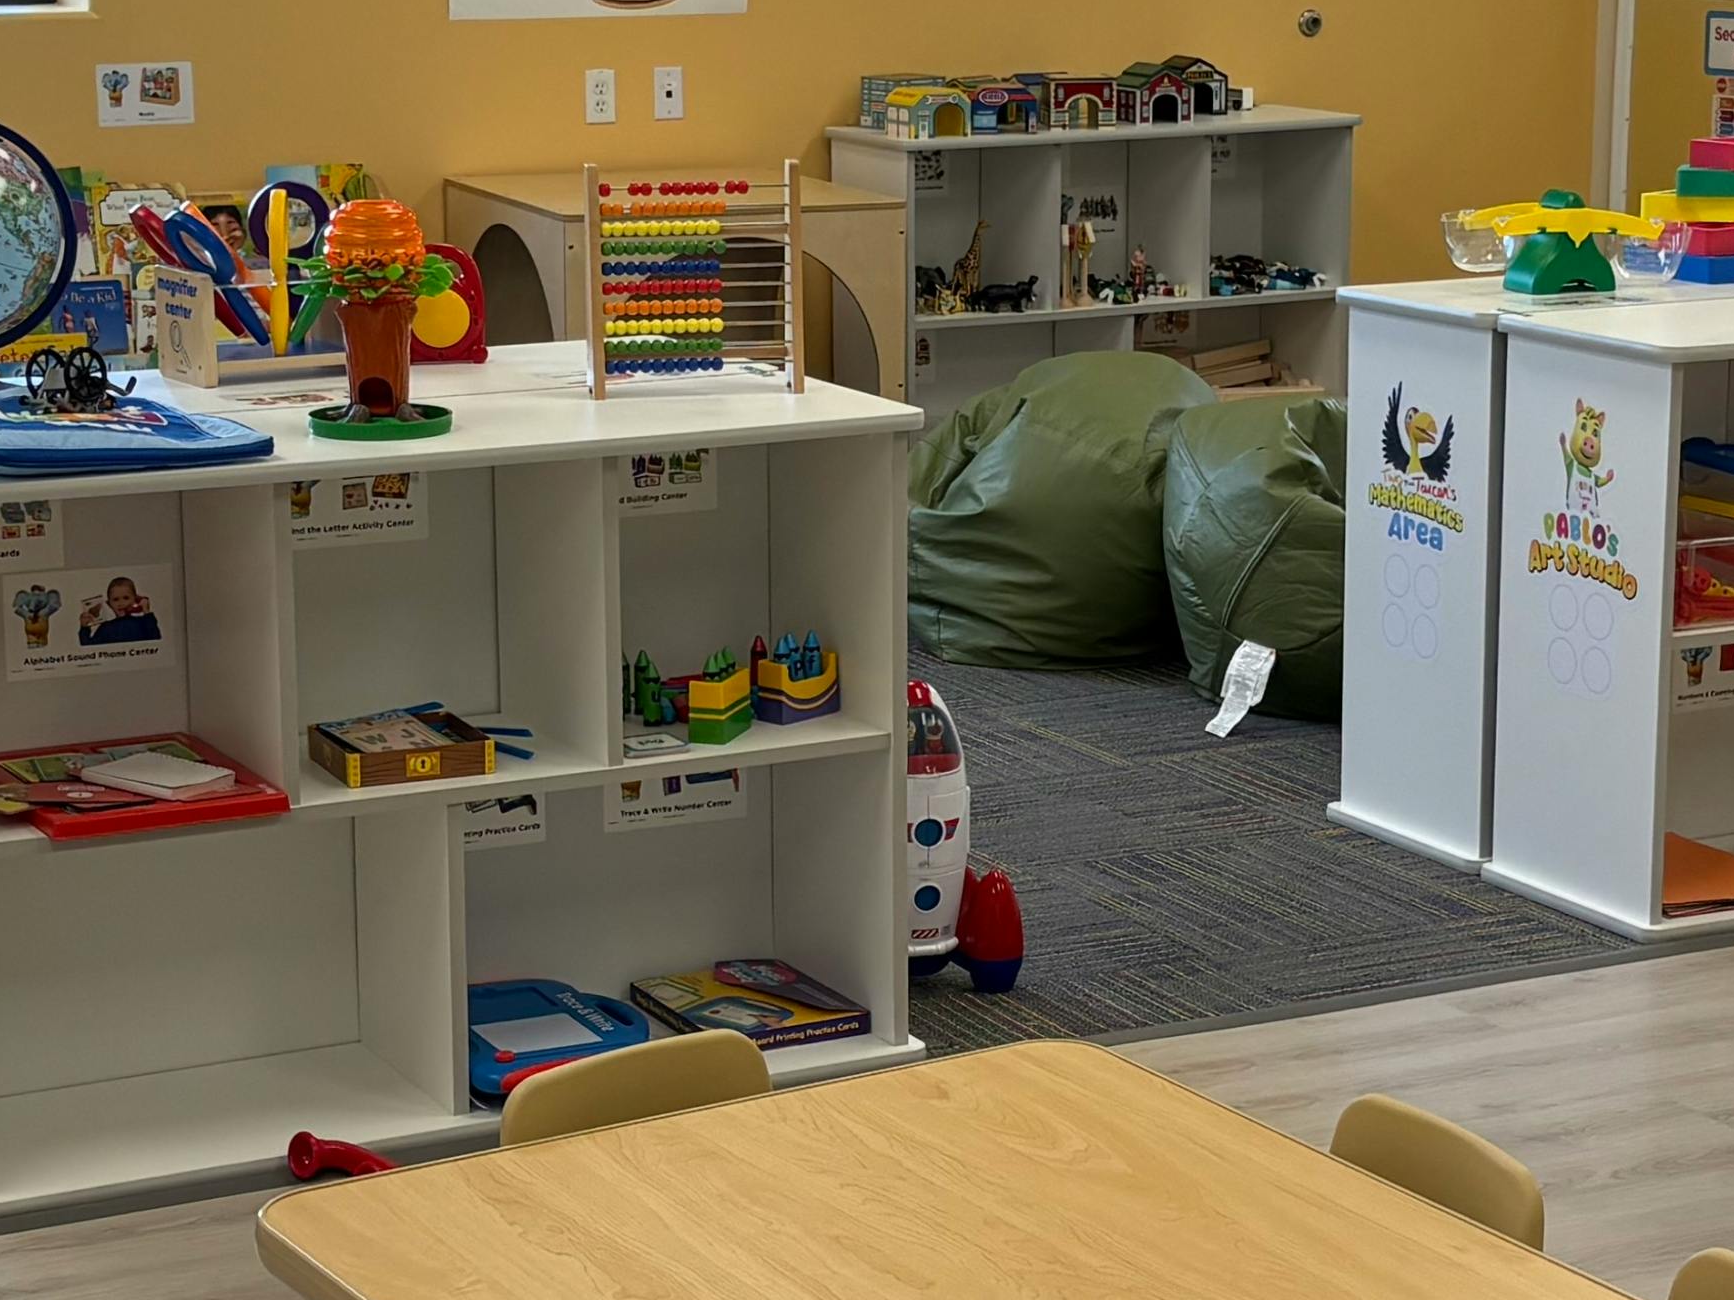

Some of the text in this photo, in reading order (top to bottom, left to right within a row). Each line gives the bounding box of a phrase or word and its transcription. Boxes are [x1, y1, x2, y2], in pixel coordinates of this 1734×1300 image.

[157, 276, 197, 298] magnifier
[165, 302, 192, 319] center
[661, 492, 688, 500] Center
[1412, 476, 1457, 502] Toucan's
[1368, 482, 1464, 533] Mathematics
[291, 518, 414, 536] ind the Letter Activity Center
[1388, 512, 1444, 551] Area
[1528, 539, 1638, 600] Art Studio
[23, 646, 160, 666] Alphabet Sound Phone Center
[620, 799, 732, 819] Trace & Write Number Center
[484, 822, 541, 837] Practice Cards
[556, 992, 584, 1009] Trace
[585, 1012, 615, 1031] Write
[776, 1031, 805, 1042] Printing
[807, 1026, 836, 1037] Practice
[837, 1021, 859, 1031] Cards
